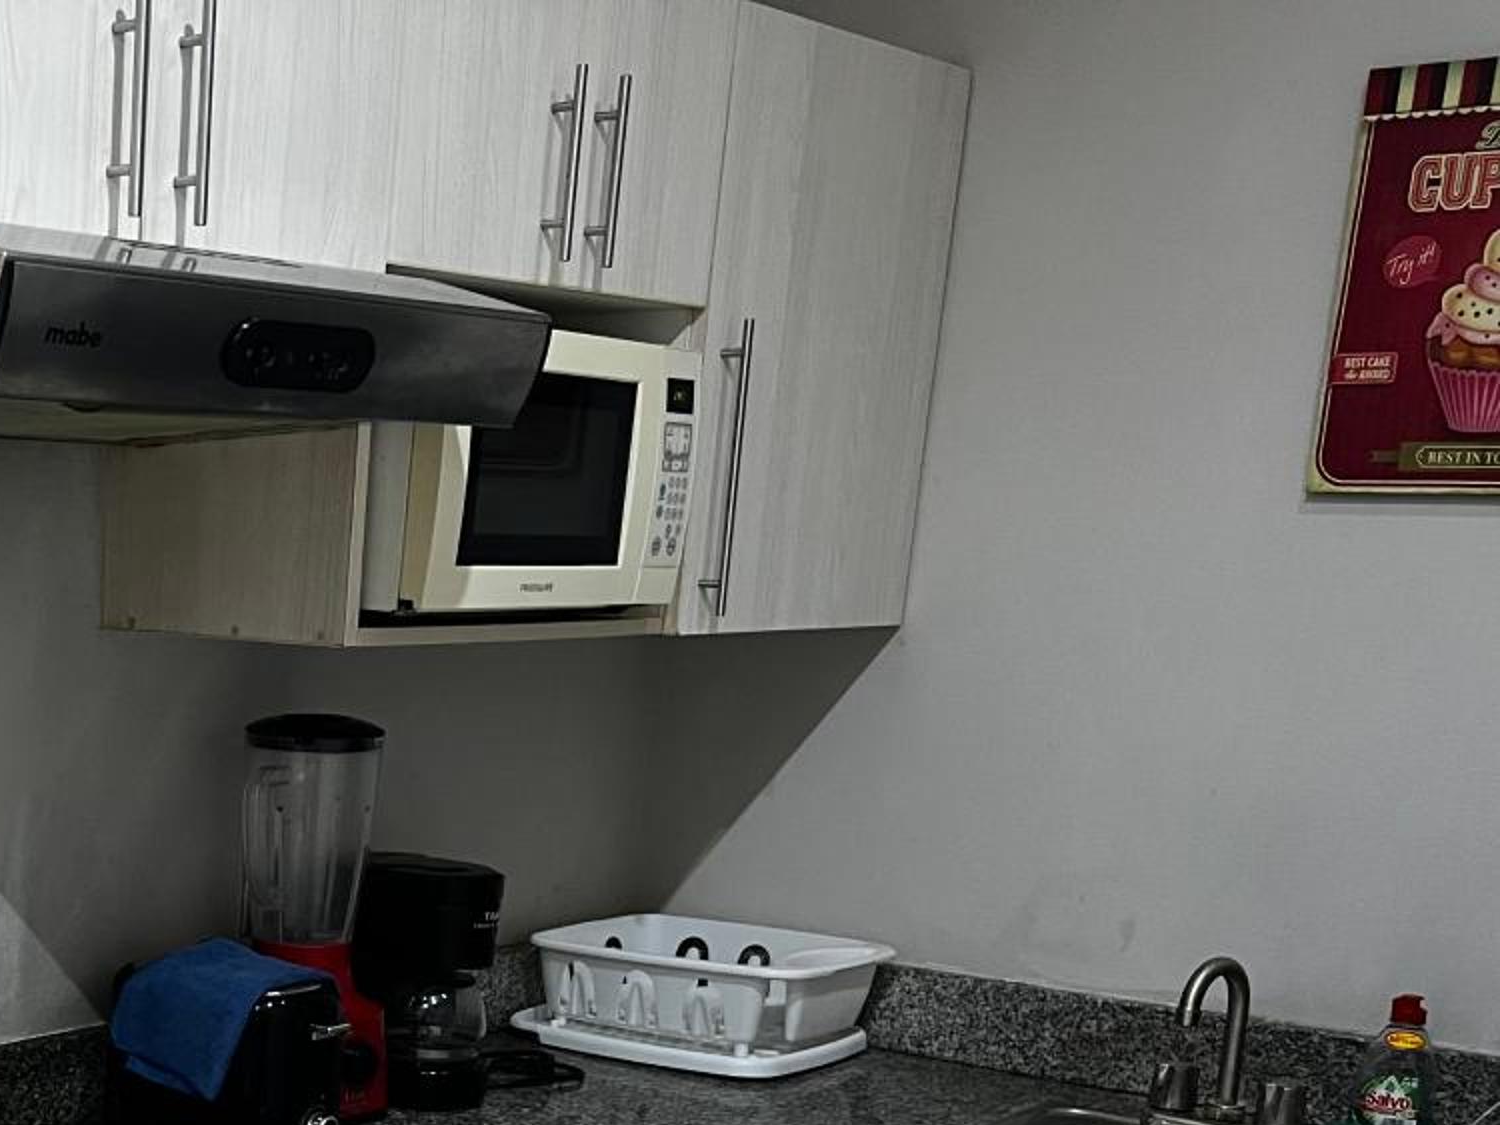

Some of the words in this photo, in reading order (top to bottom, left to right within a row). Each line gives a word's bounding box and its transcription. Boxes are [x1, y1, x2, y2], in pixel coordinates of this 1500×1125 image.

[44, 321, 102, 348] mabe
[1344, 357, 1367, 369] BEST
[1368, 355, 1391, 368] CAKE
[1427, 451, 1461, 464] BEST
[1466, 451, 1481, 464] IN
[1366, 1090, 1411, 1111] Salvo
